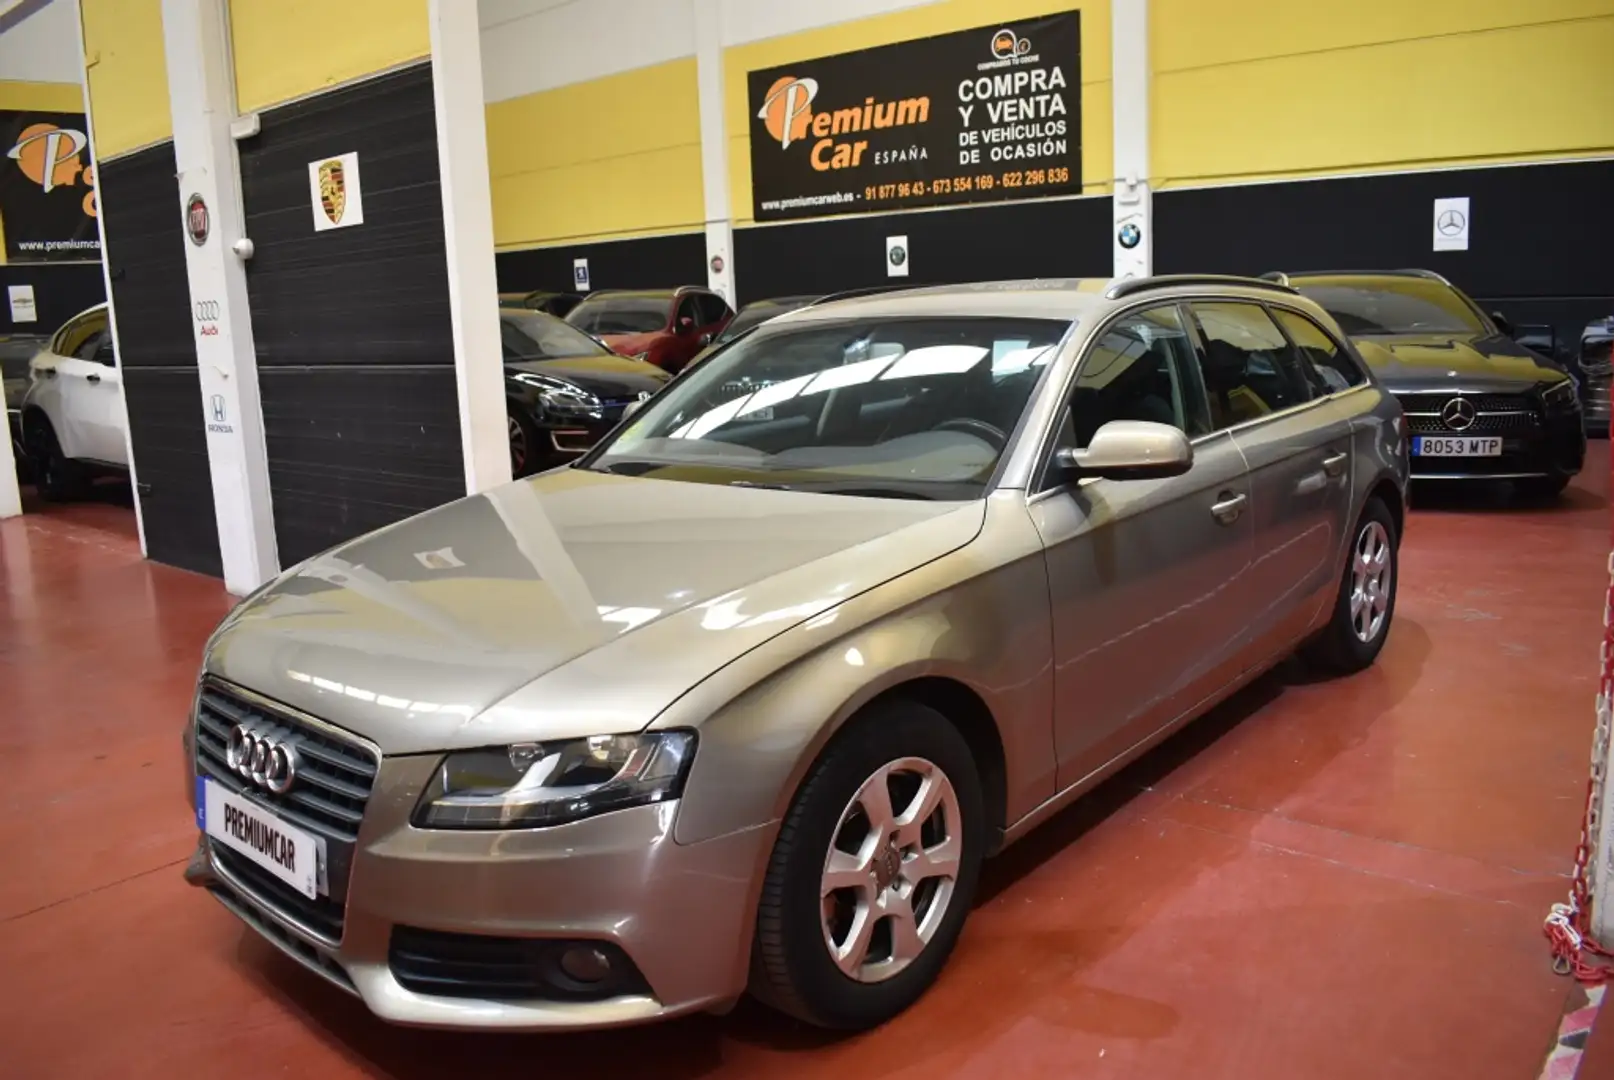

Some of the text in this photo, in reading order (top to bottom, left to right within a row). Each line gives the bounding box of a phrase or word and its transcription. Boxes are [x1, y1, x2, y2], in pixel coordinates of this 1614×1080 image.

[958, 66, 1066, 102] COMPRA
[757, 77, 930, 150] Premium
[958, 93, 1067, 127] Y VENTA
[959, 119, 1066, 146] DE VEHÍCULOS
[810, 138, 928, 171] Car ESPAÑA
[959, 137, 1066, 165] DE OCASIÓN
[761, 191, 854, 211] www.premiumcarweb.es
[865, 186, 876, 200] 91
[878, 184, 896, 200] 877
[898, 182, 910, 197] 96
[911, 181, 924, 196] 43
[933, 179, 950, 194] 673
[954, 177, 972, 193] 554
[975, 174, 994, 190] 169
[1002, 172, 1022, 187] 622
[1025, 169, 1044, 185] 296
[1048, 167, 1068, 183] 836
[201, 325, 218, 335] Audi
[1423, 440, 1464, 454] 8053
[1469, 440, 1498, 453] MTP
[224, 802, 295, 873] PREMIUMCAR
